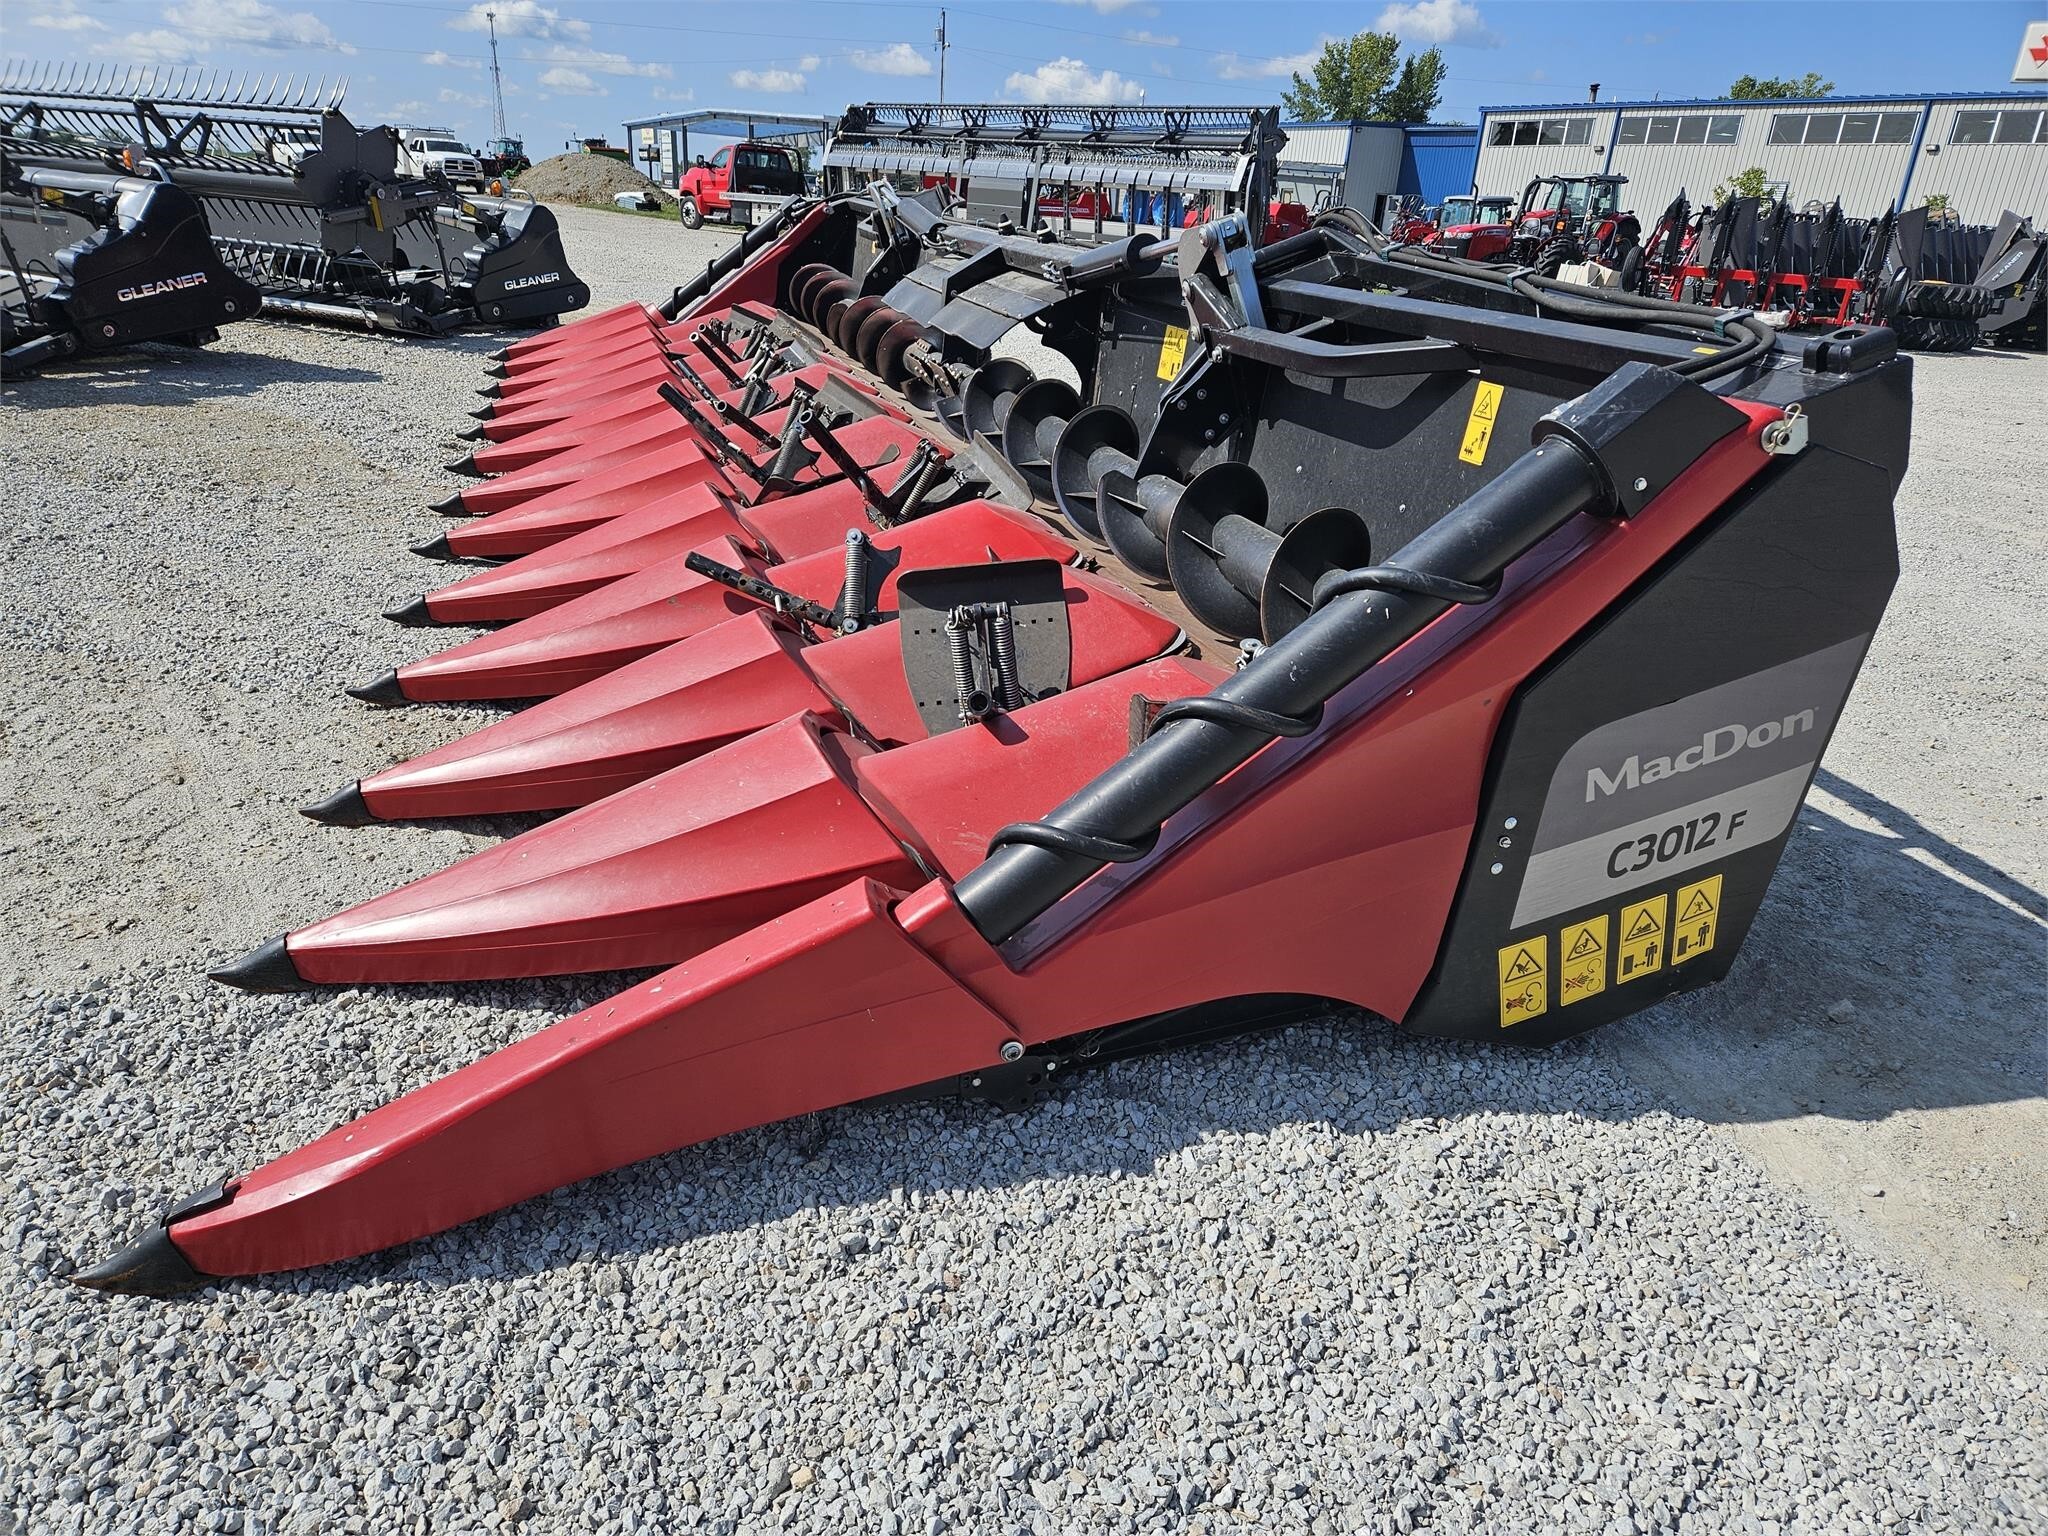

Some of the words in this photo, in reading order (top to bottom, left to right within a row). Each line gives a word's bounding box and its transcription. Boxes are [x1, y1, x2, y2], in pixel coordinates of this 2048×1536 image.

[117, 272, 208, 302] GLEANER
[504, 272, 560, 291] GLEANER
[1585, 708, 1815, 803] MacDon
[1606, 812, 1721, 879] C3012
[1725, 809, 1748, 841] F
